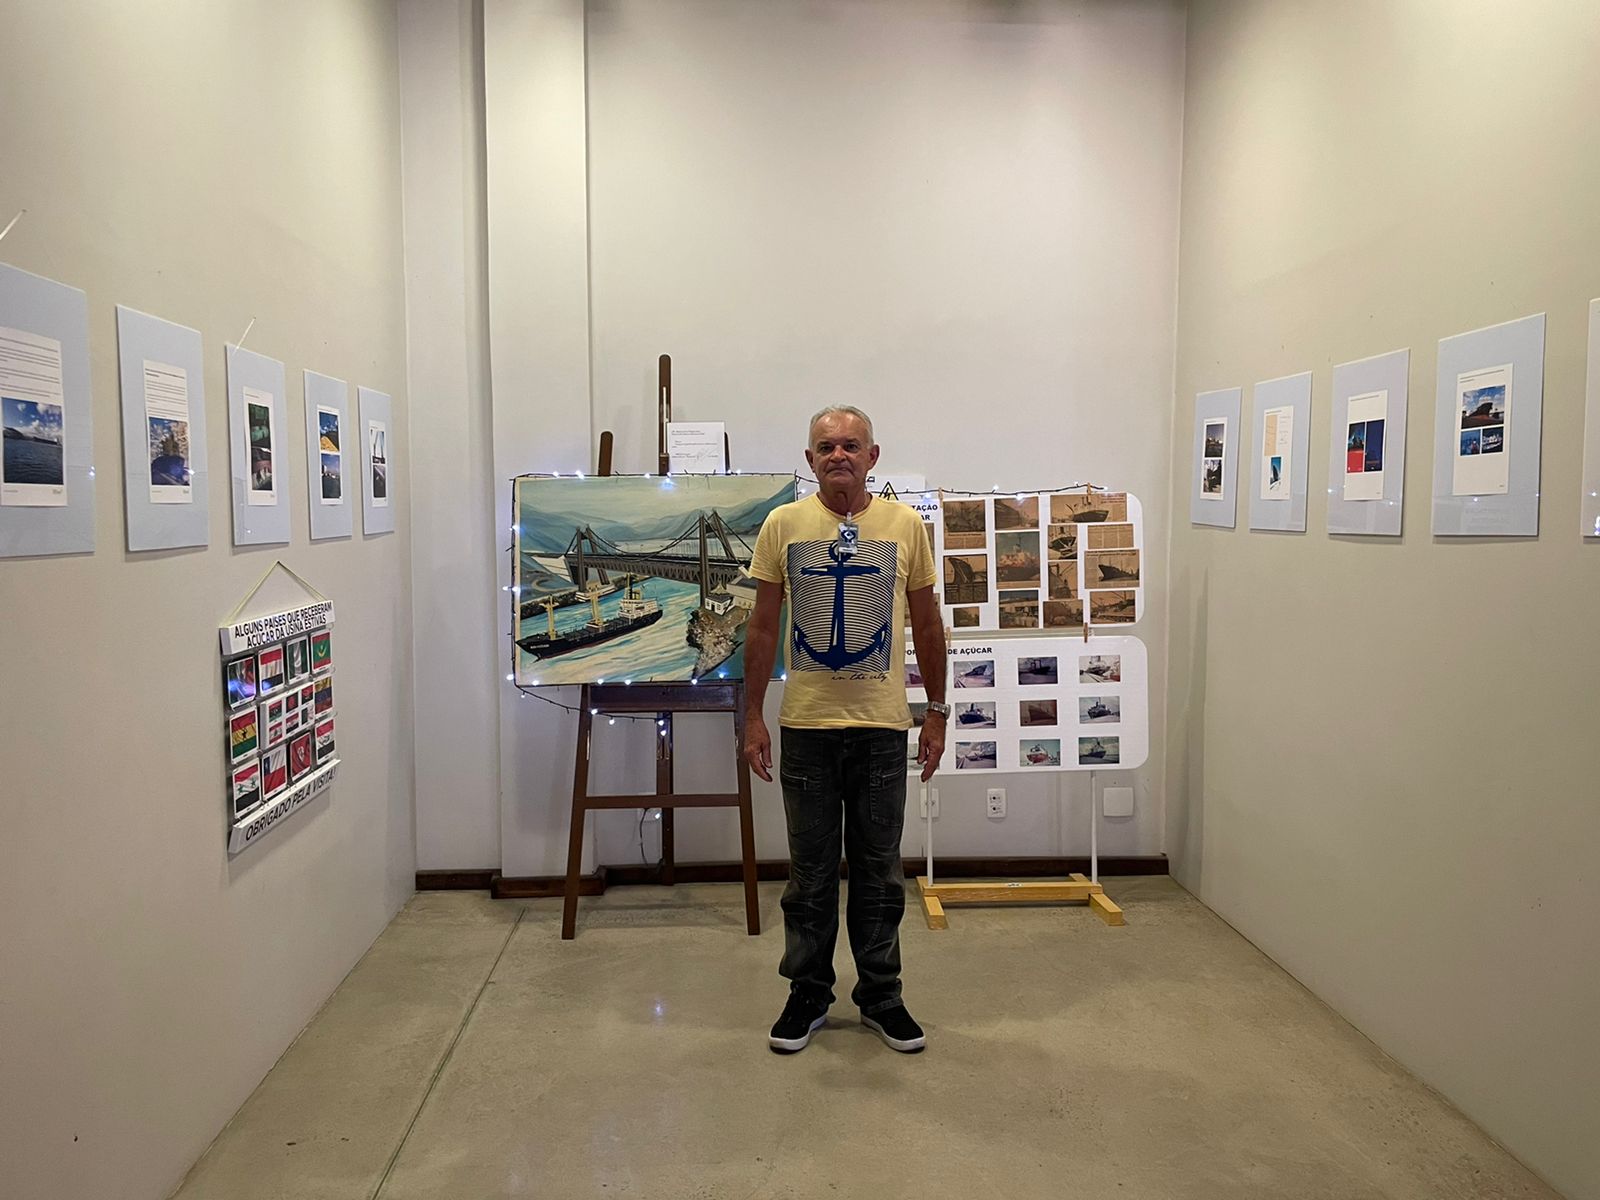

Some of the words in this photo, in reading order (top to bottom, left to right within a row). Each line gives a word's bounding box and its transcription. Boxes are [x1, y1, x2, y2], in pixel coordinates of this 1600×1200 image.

[235, 620, 263, 638] ALGUNS
[287, 611, 300, 623] QUE
[301, 602, 332, 618] RECEBERAM
[275, 627, 285, 641] DA
[285, 621, 304, 636] USINA
[305, 613, 327, 630] ESTIVAS
[959, 646, 993, 656] AÇÚCAR
[246, 798, 291, 841] OBRIGADO
[291, 784, 310, 808] PELA
